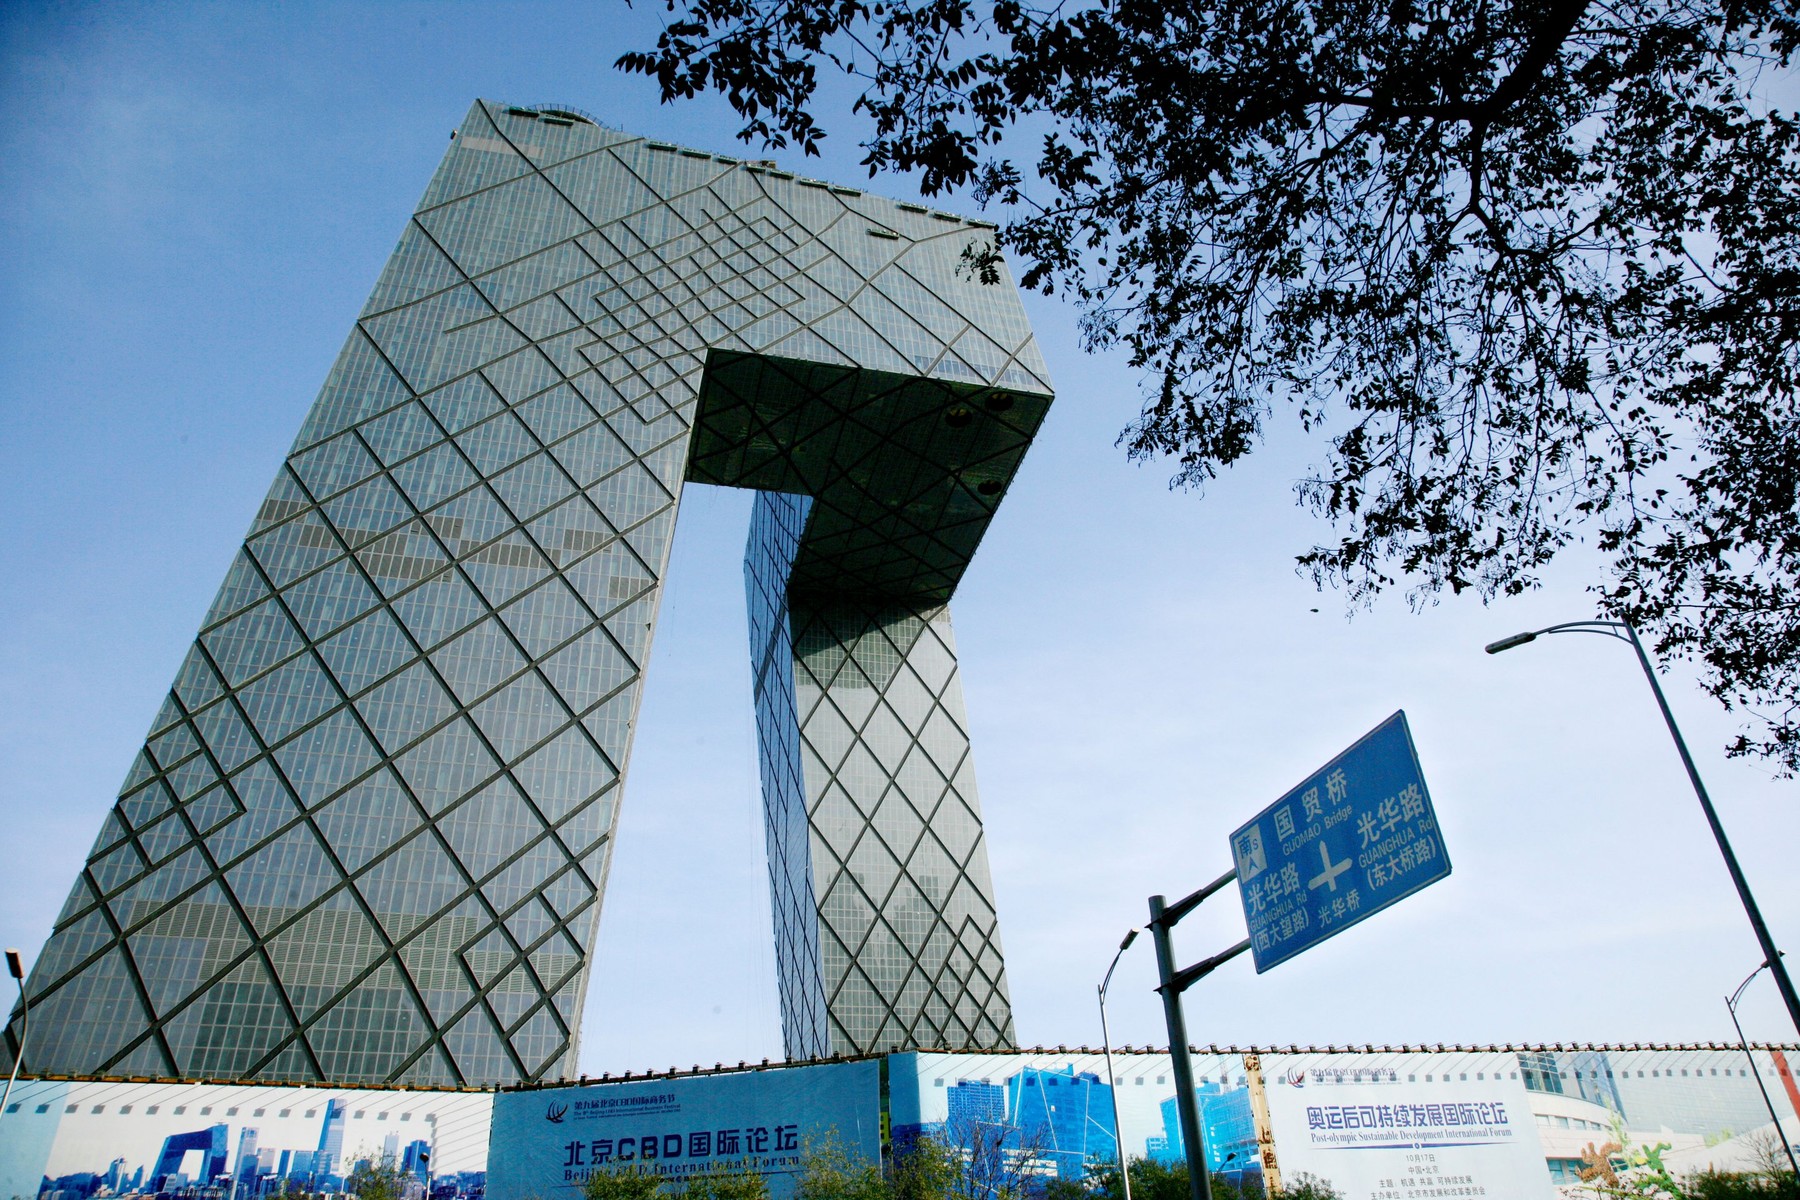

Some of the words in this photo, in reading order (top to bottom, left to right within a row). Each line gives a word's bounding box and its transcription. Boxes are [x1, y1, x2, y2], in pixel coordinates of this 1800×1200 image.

[1273, 767, 1347, 843] 国贸桥
[1357, 783, 1425, 850] 光华路
[1237, 834, 1253, 860] 南
[1252, 838, 1259, 850] S
[1282, 822, 1321, 856] GUOMAO
[1323, 804, 1352, 830] Bridge
[1358, 826, 1416, 868] GUANGHUA
[1417, 814, 1433, 834] Rd
[1367, 834, 1436, 891] (东大桥路)
[1248, 861, 1300, 916] 光华路
[1318, 888, 1360, 928] 光华桥
[1250, 898, 1294, 933] GUANGHUA
[1295, 889, 1308, 906] Rd
[1254, 906, 1309, 953] (西大望路)
[1306, 1102, 1509, 1130] 奥运后可持续发展国际论坛
[1310, 1131, 1357, 1145] Post-olympic
[1358, 1130, 1399, 1142] Sustainable
[1400, 1129, 1444, 1142] Development
[1445, 1128, 1489, 1139] International
[1489, 1127, 1512, 1137] Forum
[563, 1124, 798, 1167] 北京CBD国际论坛
[753, 1155, 799, 1168] Forum
[1406, 1153, 1436, 1163] 10月17日
